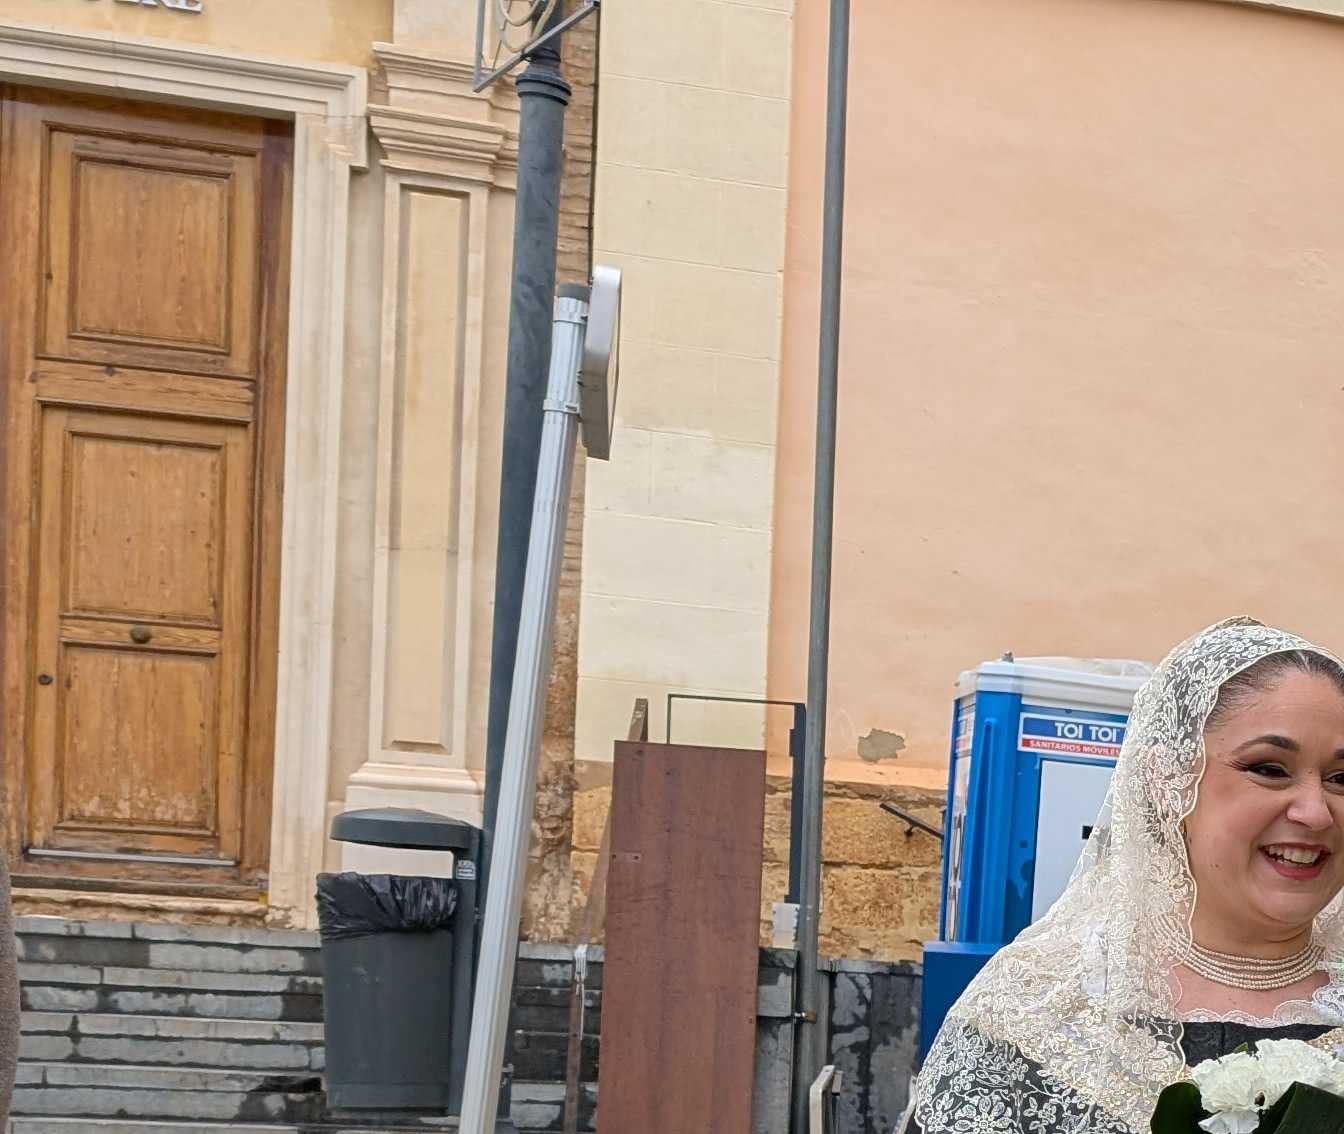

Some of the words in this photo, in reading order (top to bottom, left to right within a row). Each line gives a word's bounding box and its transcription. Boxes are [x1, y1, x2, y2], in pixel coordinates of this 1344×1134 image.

[1055, 721, 1083, 739] TOI
[1089, 726, 1117, 743] TOI
[1029, 740, 1081, 753] SANITARIOS
